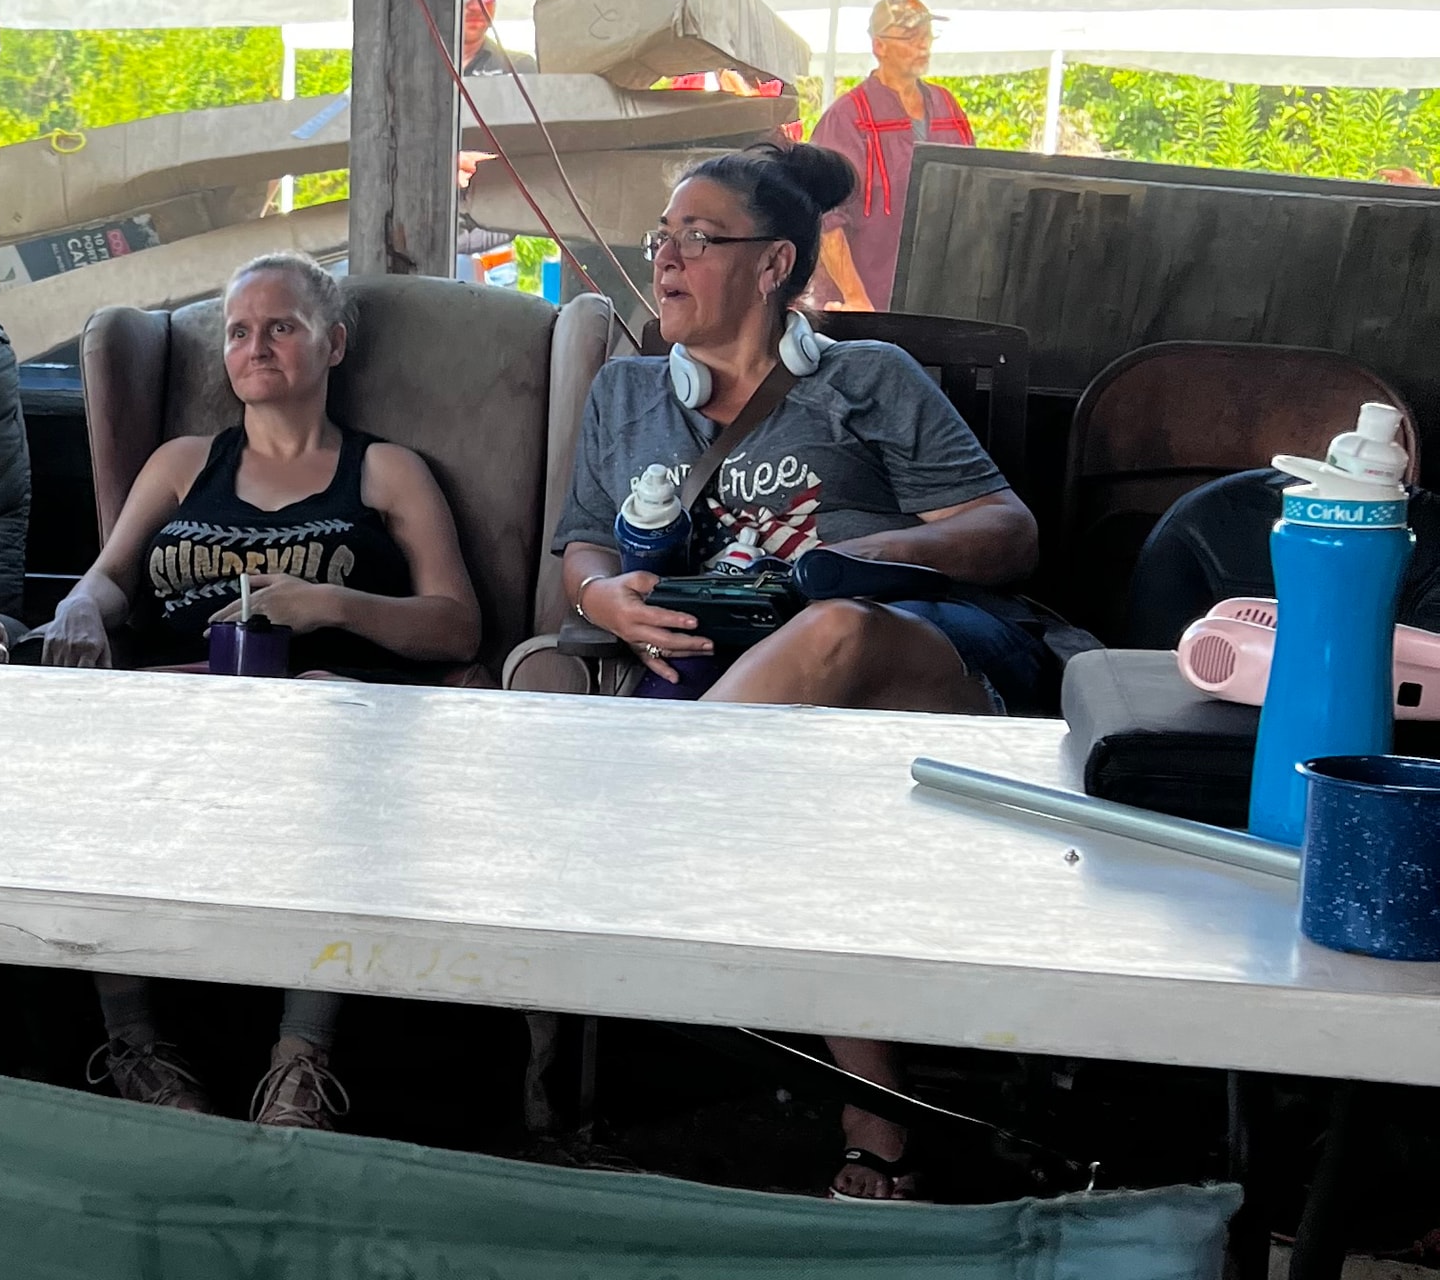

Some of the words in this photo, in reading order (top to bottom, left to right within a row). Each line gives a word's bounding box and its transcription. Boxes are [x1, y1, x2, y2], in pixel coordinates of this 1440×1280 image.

[82, 235, 98, 264] PORT
[717, 451, 809, 504] Free
[1306, 503, 1364, 522] Cirkul
